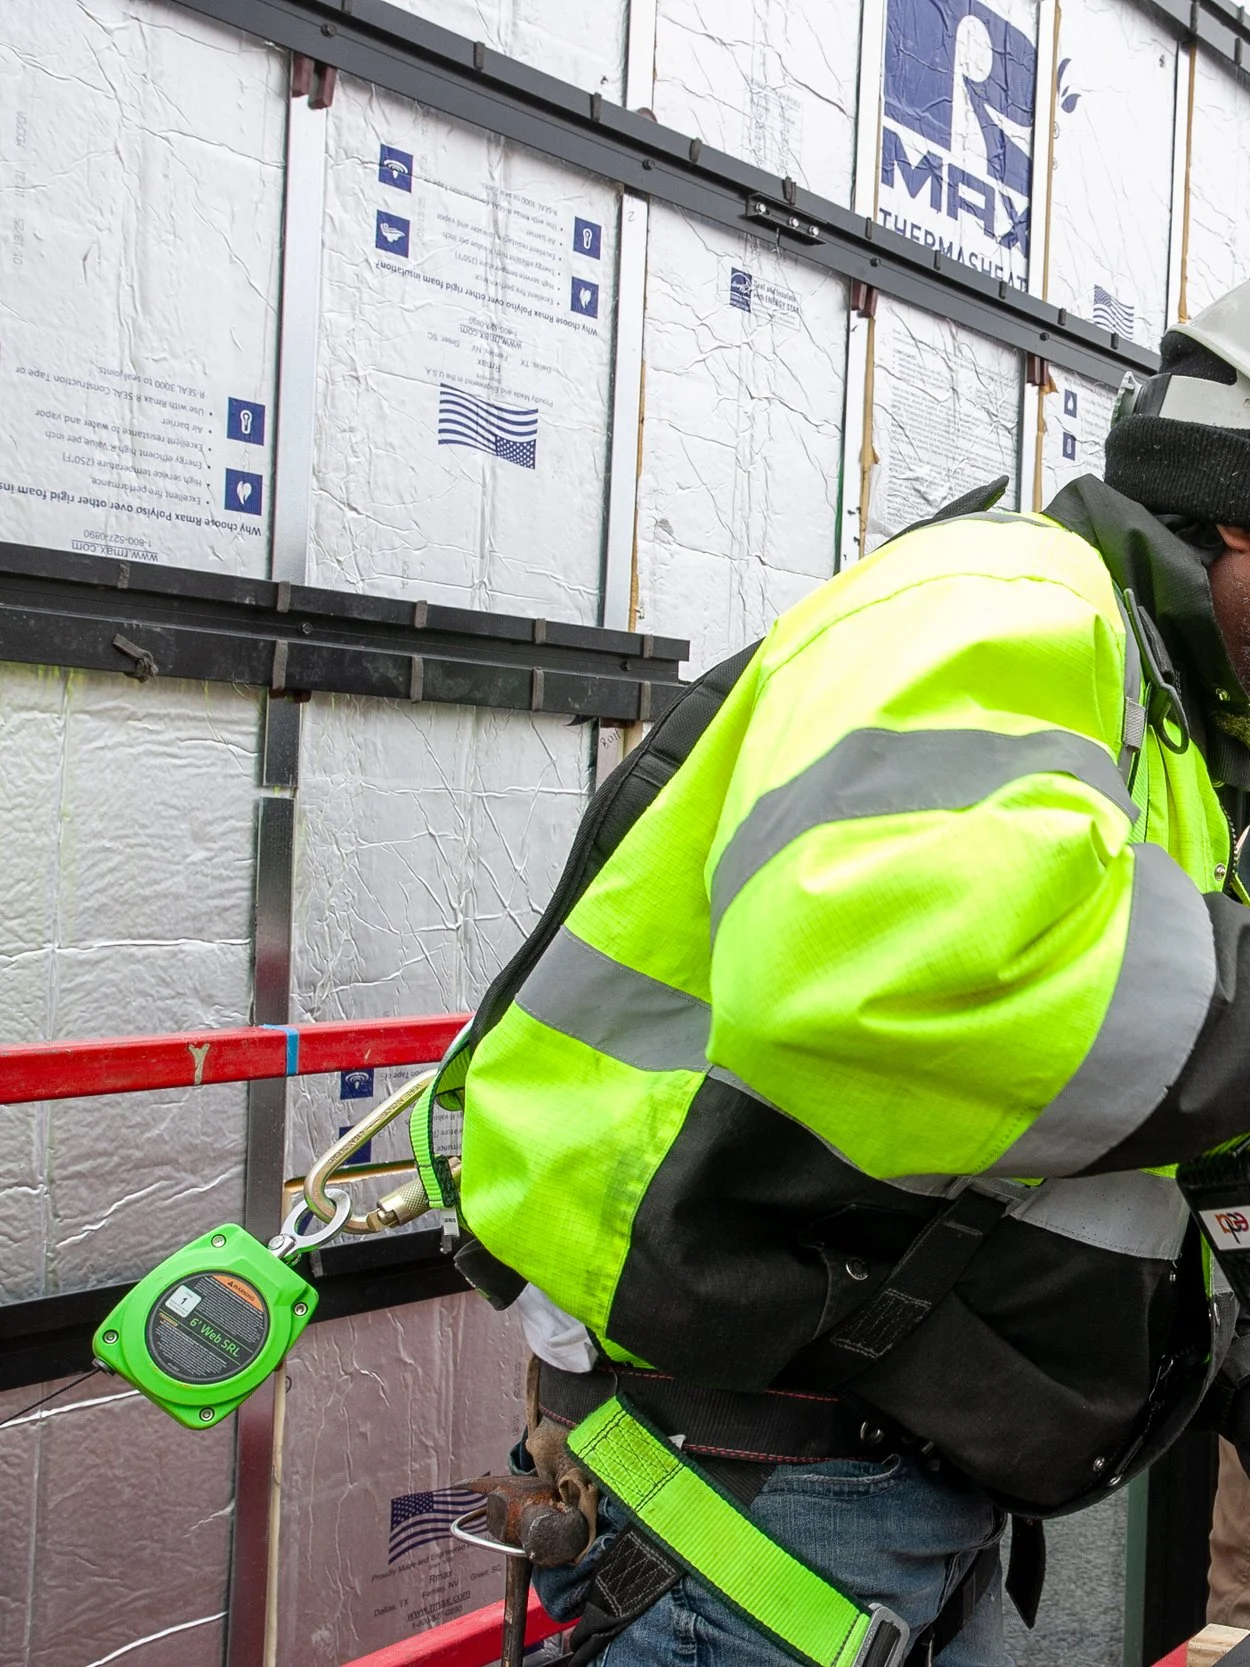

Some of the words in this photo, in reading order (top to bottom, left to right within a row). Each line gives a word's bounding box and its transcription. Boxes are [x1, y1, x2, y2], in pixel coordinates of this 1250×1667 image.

[881, 125, 1030, 260] MAX
[436, 211, 455, 225] vapor
[456, 220, 469, 230] and
[525, 228, 545, 243] barrier
[546, 236, 556, 246] Air
[529, 244, 555, 260] Excellent
[375, 259, 420, 282] insulation?
[423, 274, 443, 289] foam
[445, 279, 462, 295] rigid
[464, 287, 485, 301] other
[487, 294, 504, 306] over
[527, 290, 553, 305] Excellent
[506, 299, 532, 316] Polyiso
[533, 309, 553, 322] Rmax
[554, 315, 579, 331] choose
[580, 323, 597, 336] Why
[15, 365, 25, 375] or
[28, 366, 50, 381] Tape
[122, 370, 140, 384] seal
[52, 373, 110, 396] Construction
[142, 376, 152, 386] to
[176, 383, 204, 399] R-SEAL
[513, 389, 529, 401] Made
[143, 395, 166, 409] Rmax
[169, 401, 187, 413] with
[35, 406, 61, 422] vapor
[189, 405, 204, 416] Use
[64, 414, 81, 426] and
[83, 418, 108, 432] water
[161, 417, 189, 431] barrier
[44, 428, 64, 442] inch
[110, 424, 120, 434] to
[122, 426, 164, 444] resistance
[191, 423, 203, 434] Air
[66, 431, 81, 444] per
[167, 435, 203, 452] Excellent
[117, 443, 136, 457] high
[138, 448, 172, 464] efficient
[61, 450, 94, 467] (250°F)
[175, 454, 202, 470] Energy
[96, 456, 151, 478] temperature
[91, 473, 146, 495] performance
[153, 470, 181, 483] service
[183, 475, 201, 487] High
[16, 483, 46, 499] foam
[49, 488, 74, 504] rigid
[147, 486, 162, 498] fire
[164, 490, 200, 506] Excellent
[77, 494, 106, 509] other
[110, 500, 132, 512] over
[135, 502, 171, 521] Polyiso
[174, 512, 201, 525] Rmax
[203, 517, 237, 533] choose
[239, 522, 261, 536] Why
[83, 528, 151, 549] 1-800-527-0890
[71, 537, 158, 564] www.rmax.com
[232, 1285, 255, 1301] WARNING
[180, 1297, 187, 1305] 1
[189, 1317, 202, 1327] 6'
[200, 1325, 222, 1343] Web
[220, 1338, 242, 1358] SRL
[429, 1567, 452, 1584] Rmax
[399, 1598, 408, 1608] TX
[447, 1579, 459, 1589] NV
[491, 1562, 501, 1573] SC
[407, 1589, 471, 1621] www.rmax.com
